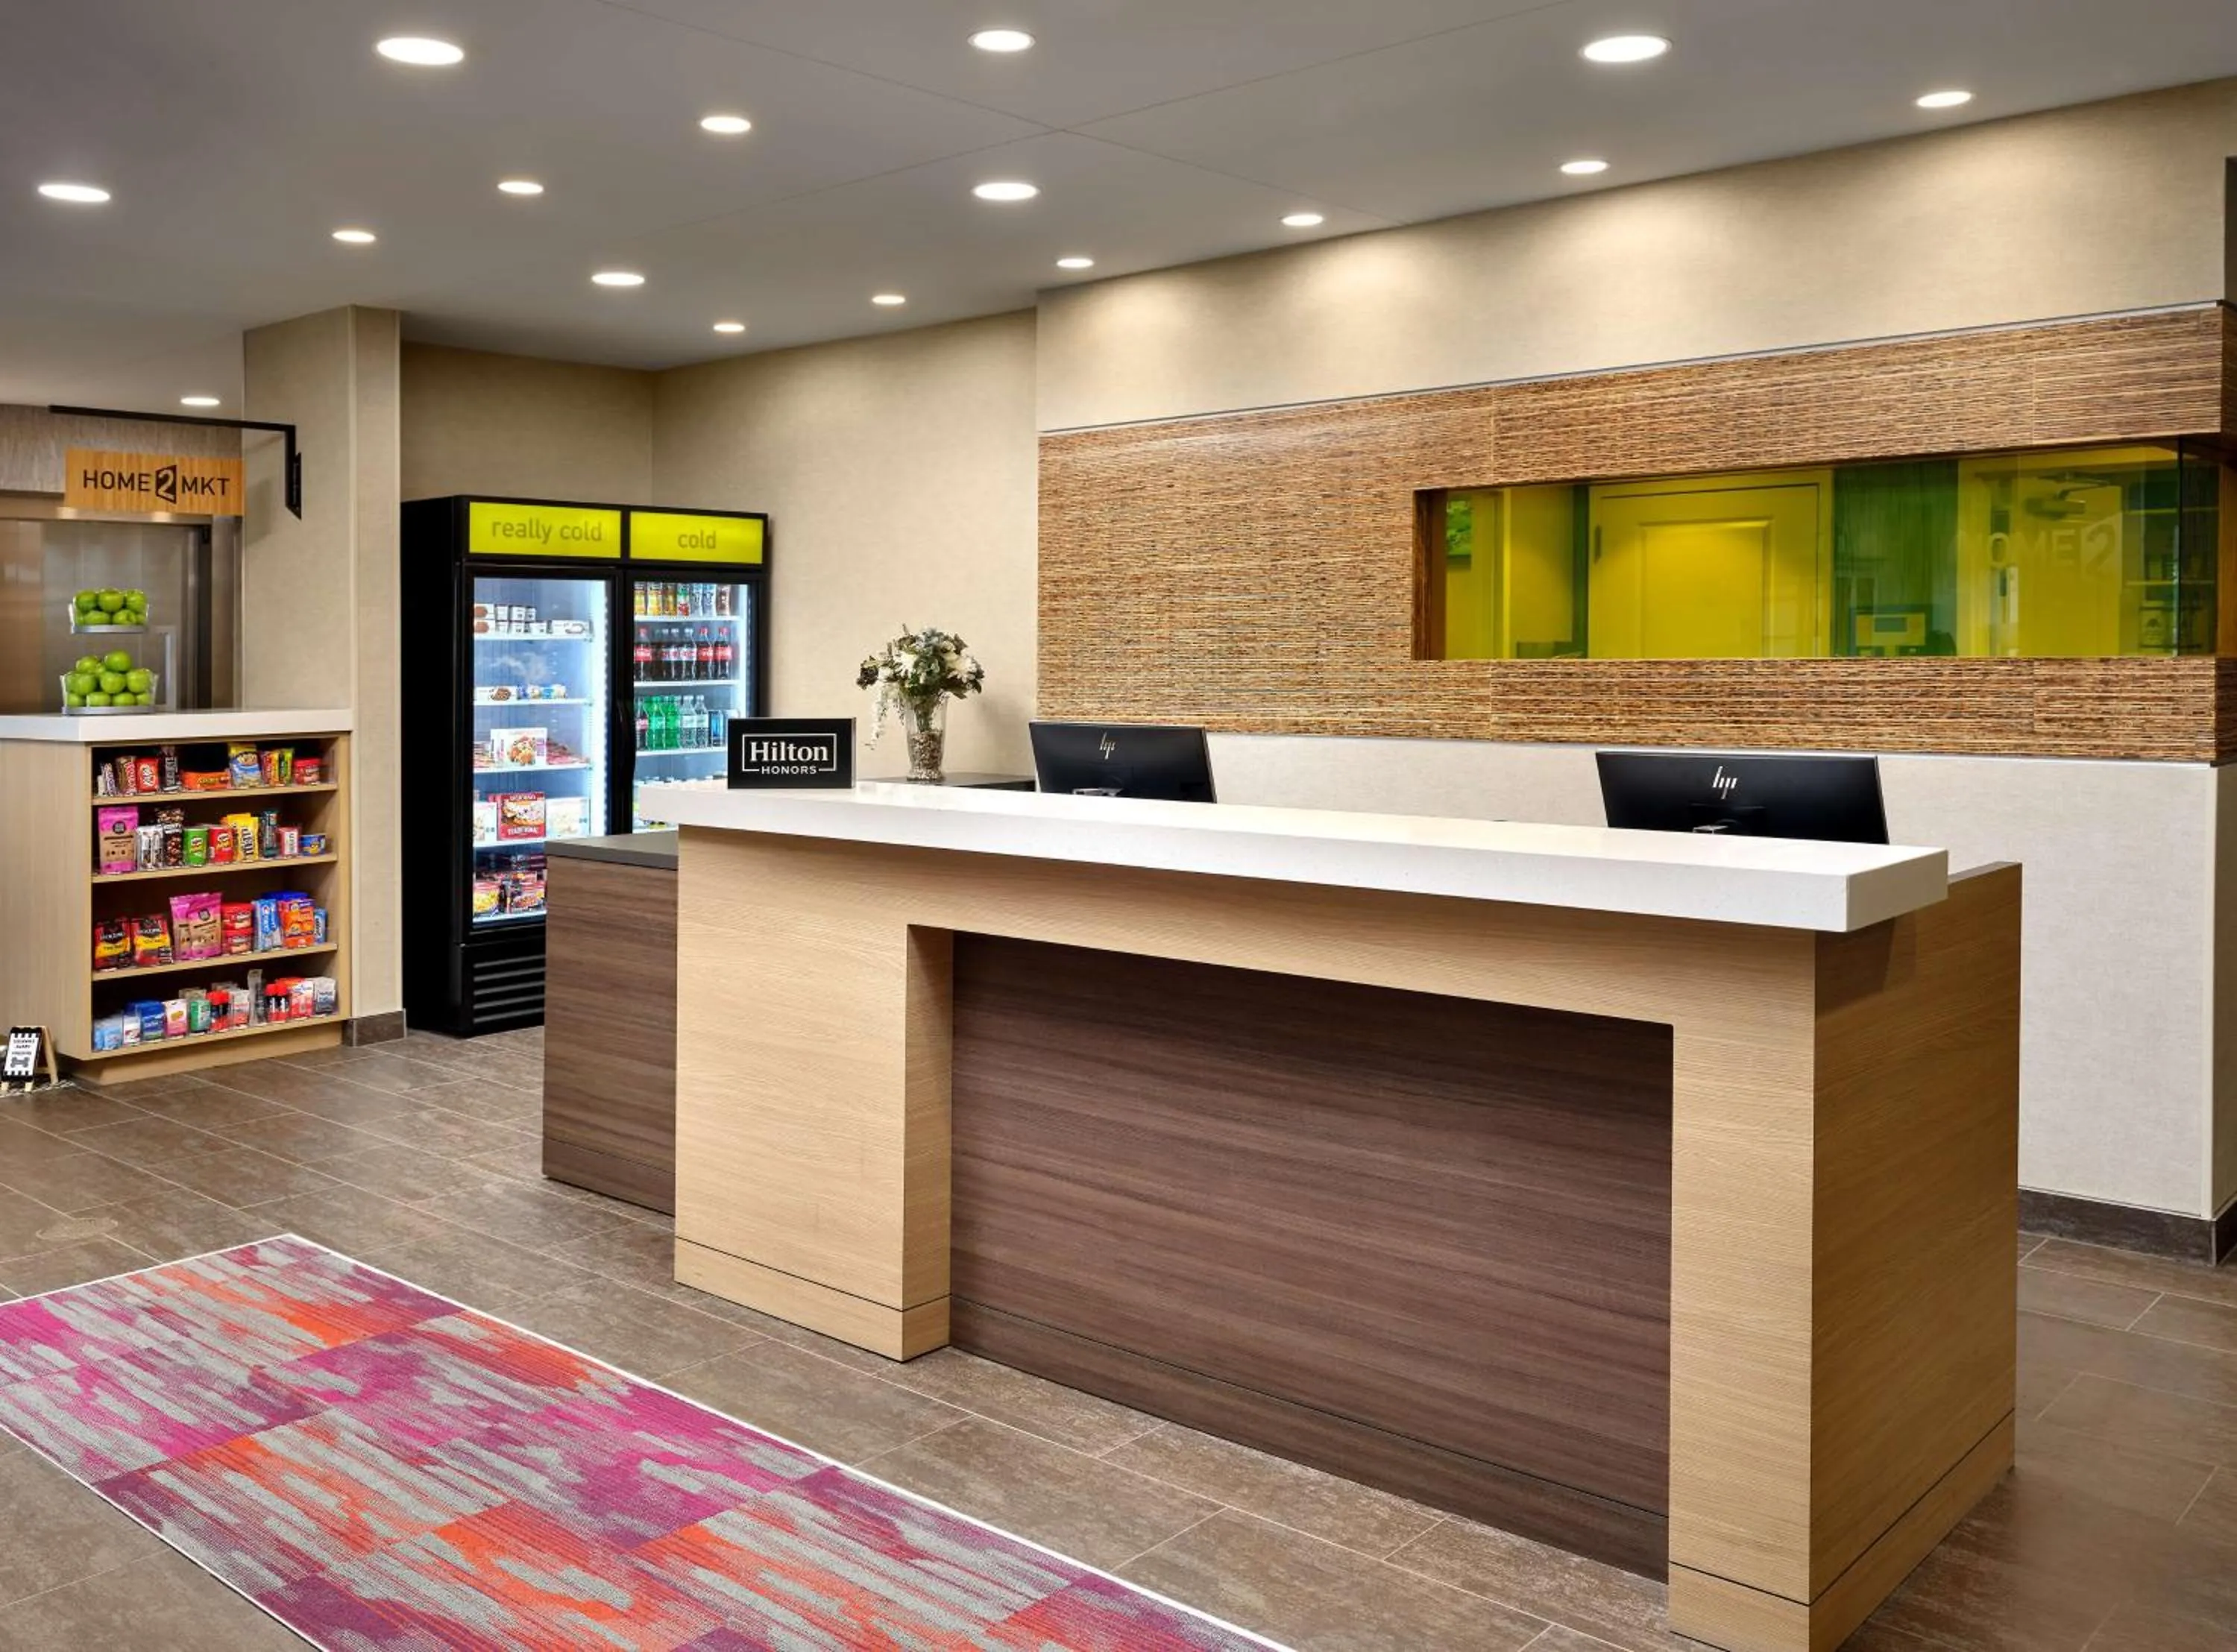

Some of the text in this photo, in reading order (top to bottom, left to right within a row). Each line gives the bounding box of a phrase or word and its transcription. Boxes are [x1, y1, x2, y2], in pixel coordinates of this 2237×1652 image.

[492, 518, 602, 545] really cold
[678, 530, 717, 549] cold
[750, 742, 829, 761] Hilton
[761, 766, 817, 775] HONORS
